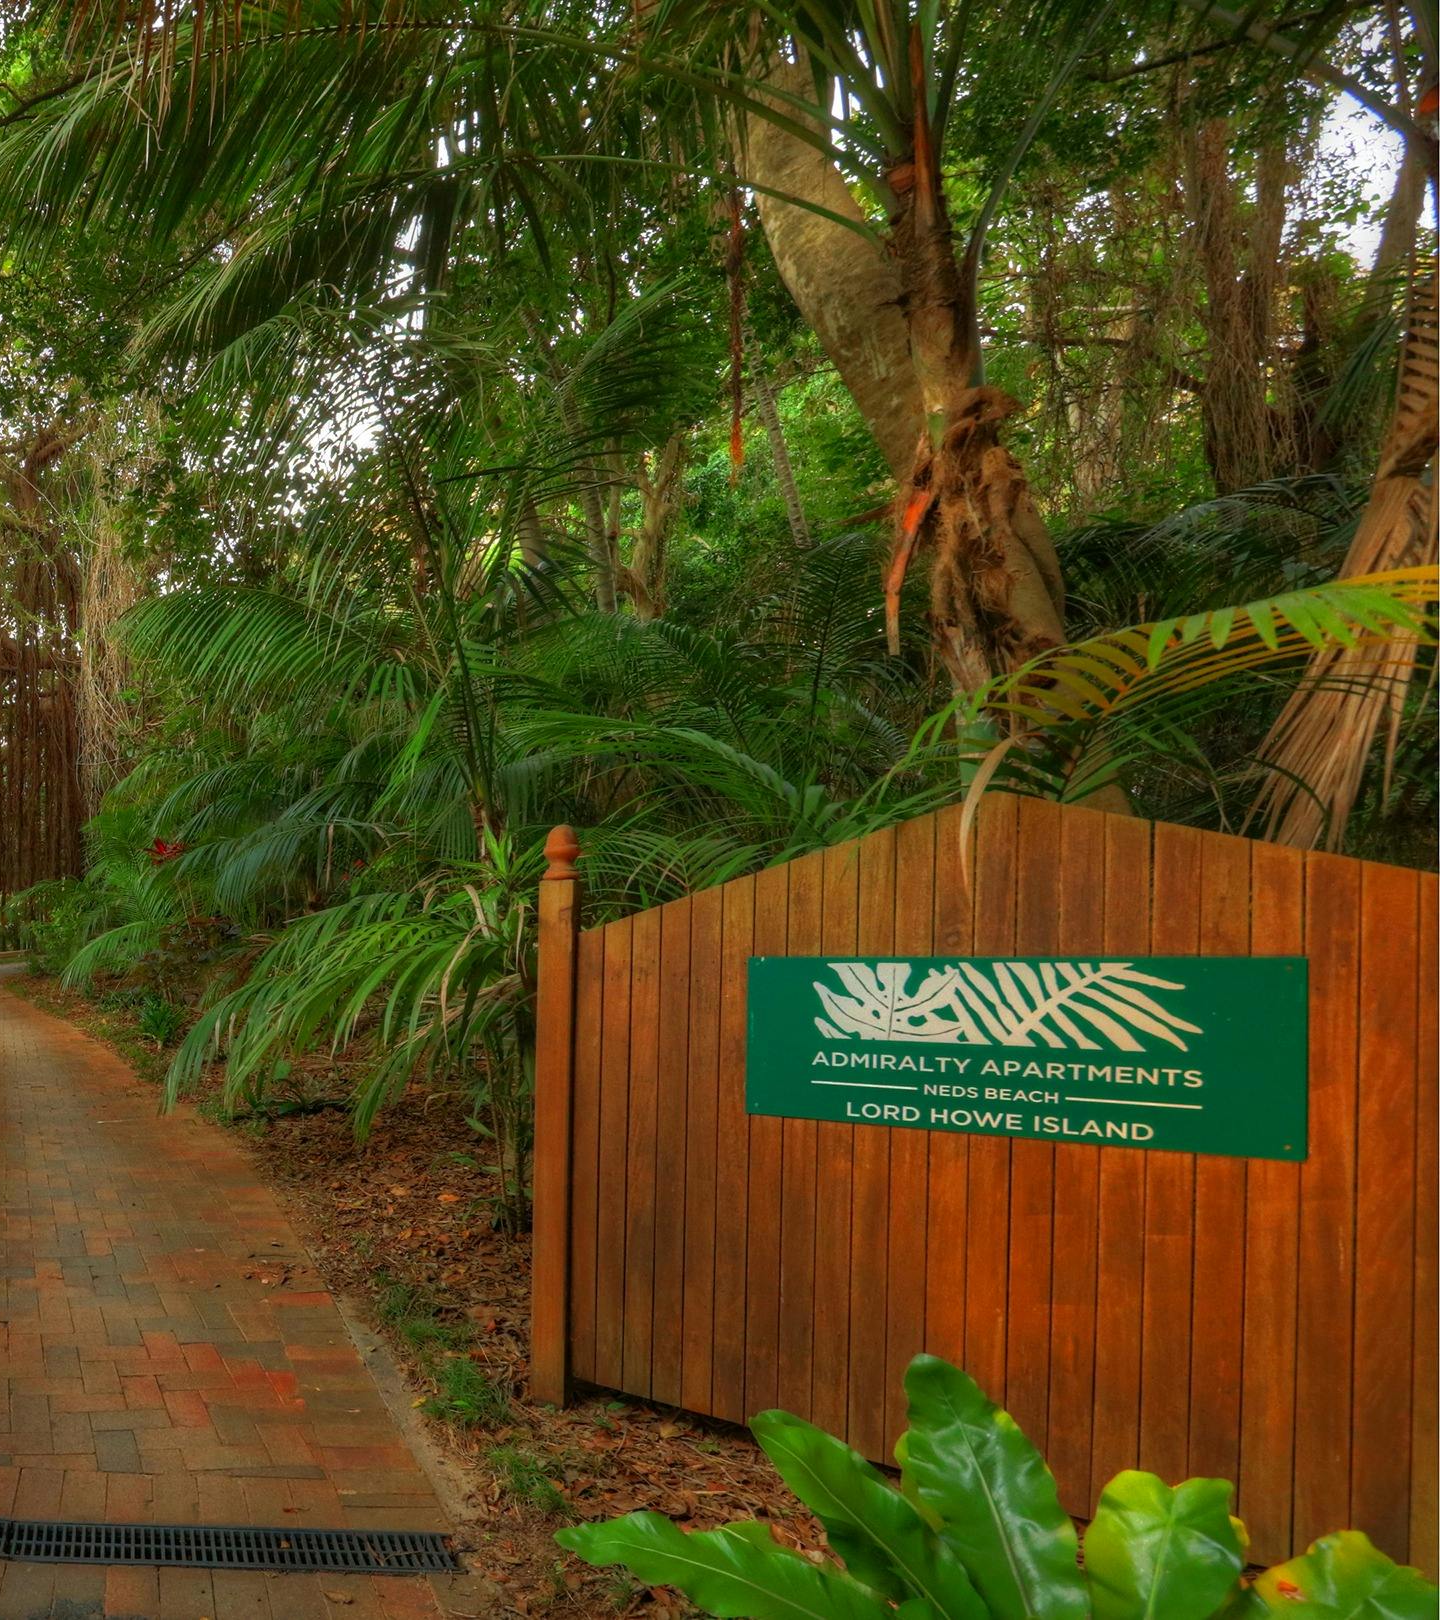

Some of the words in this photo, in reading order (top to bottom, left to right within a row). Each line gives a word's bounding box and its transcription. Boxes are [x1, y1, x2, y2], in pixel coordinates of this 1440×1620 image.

[812, 1050, 971, 1075] ADMIRALTY
[981, 1059, 1203, 1088] APARTMENTS
[924, 1084, 978, 1099] NEDS
[984, 1087, 1059, 1104] BEACH
[846, 1102, 920, 1122] LORD
[930, 1108, 1023, 1130] HOWE
[1034, 1115, 1154, 1141] ISLAND
